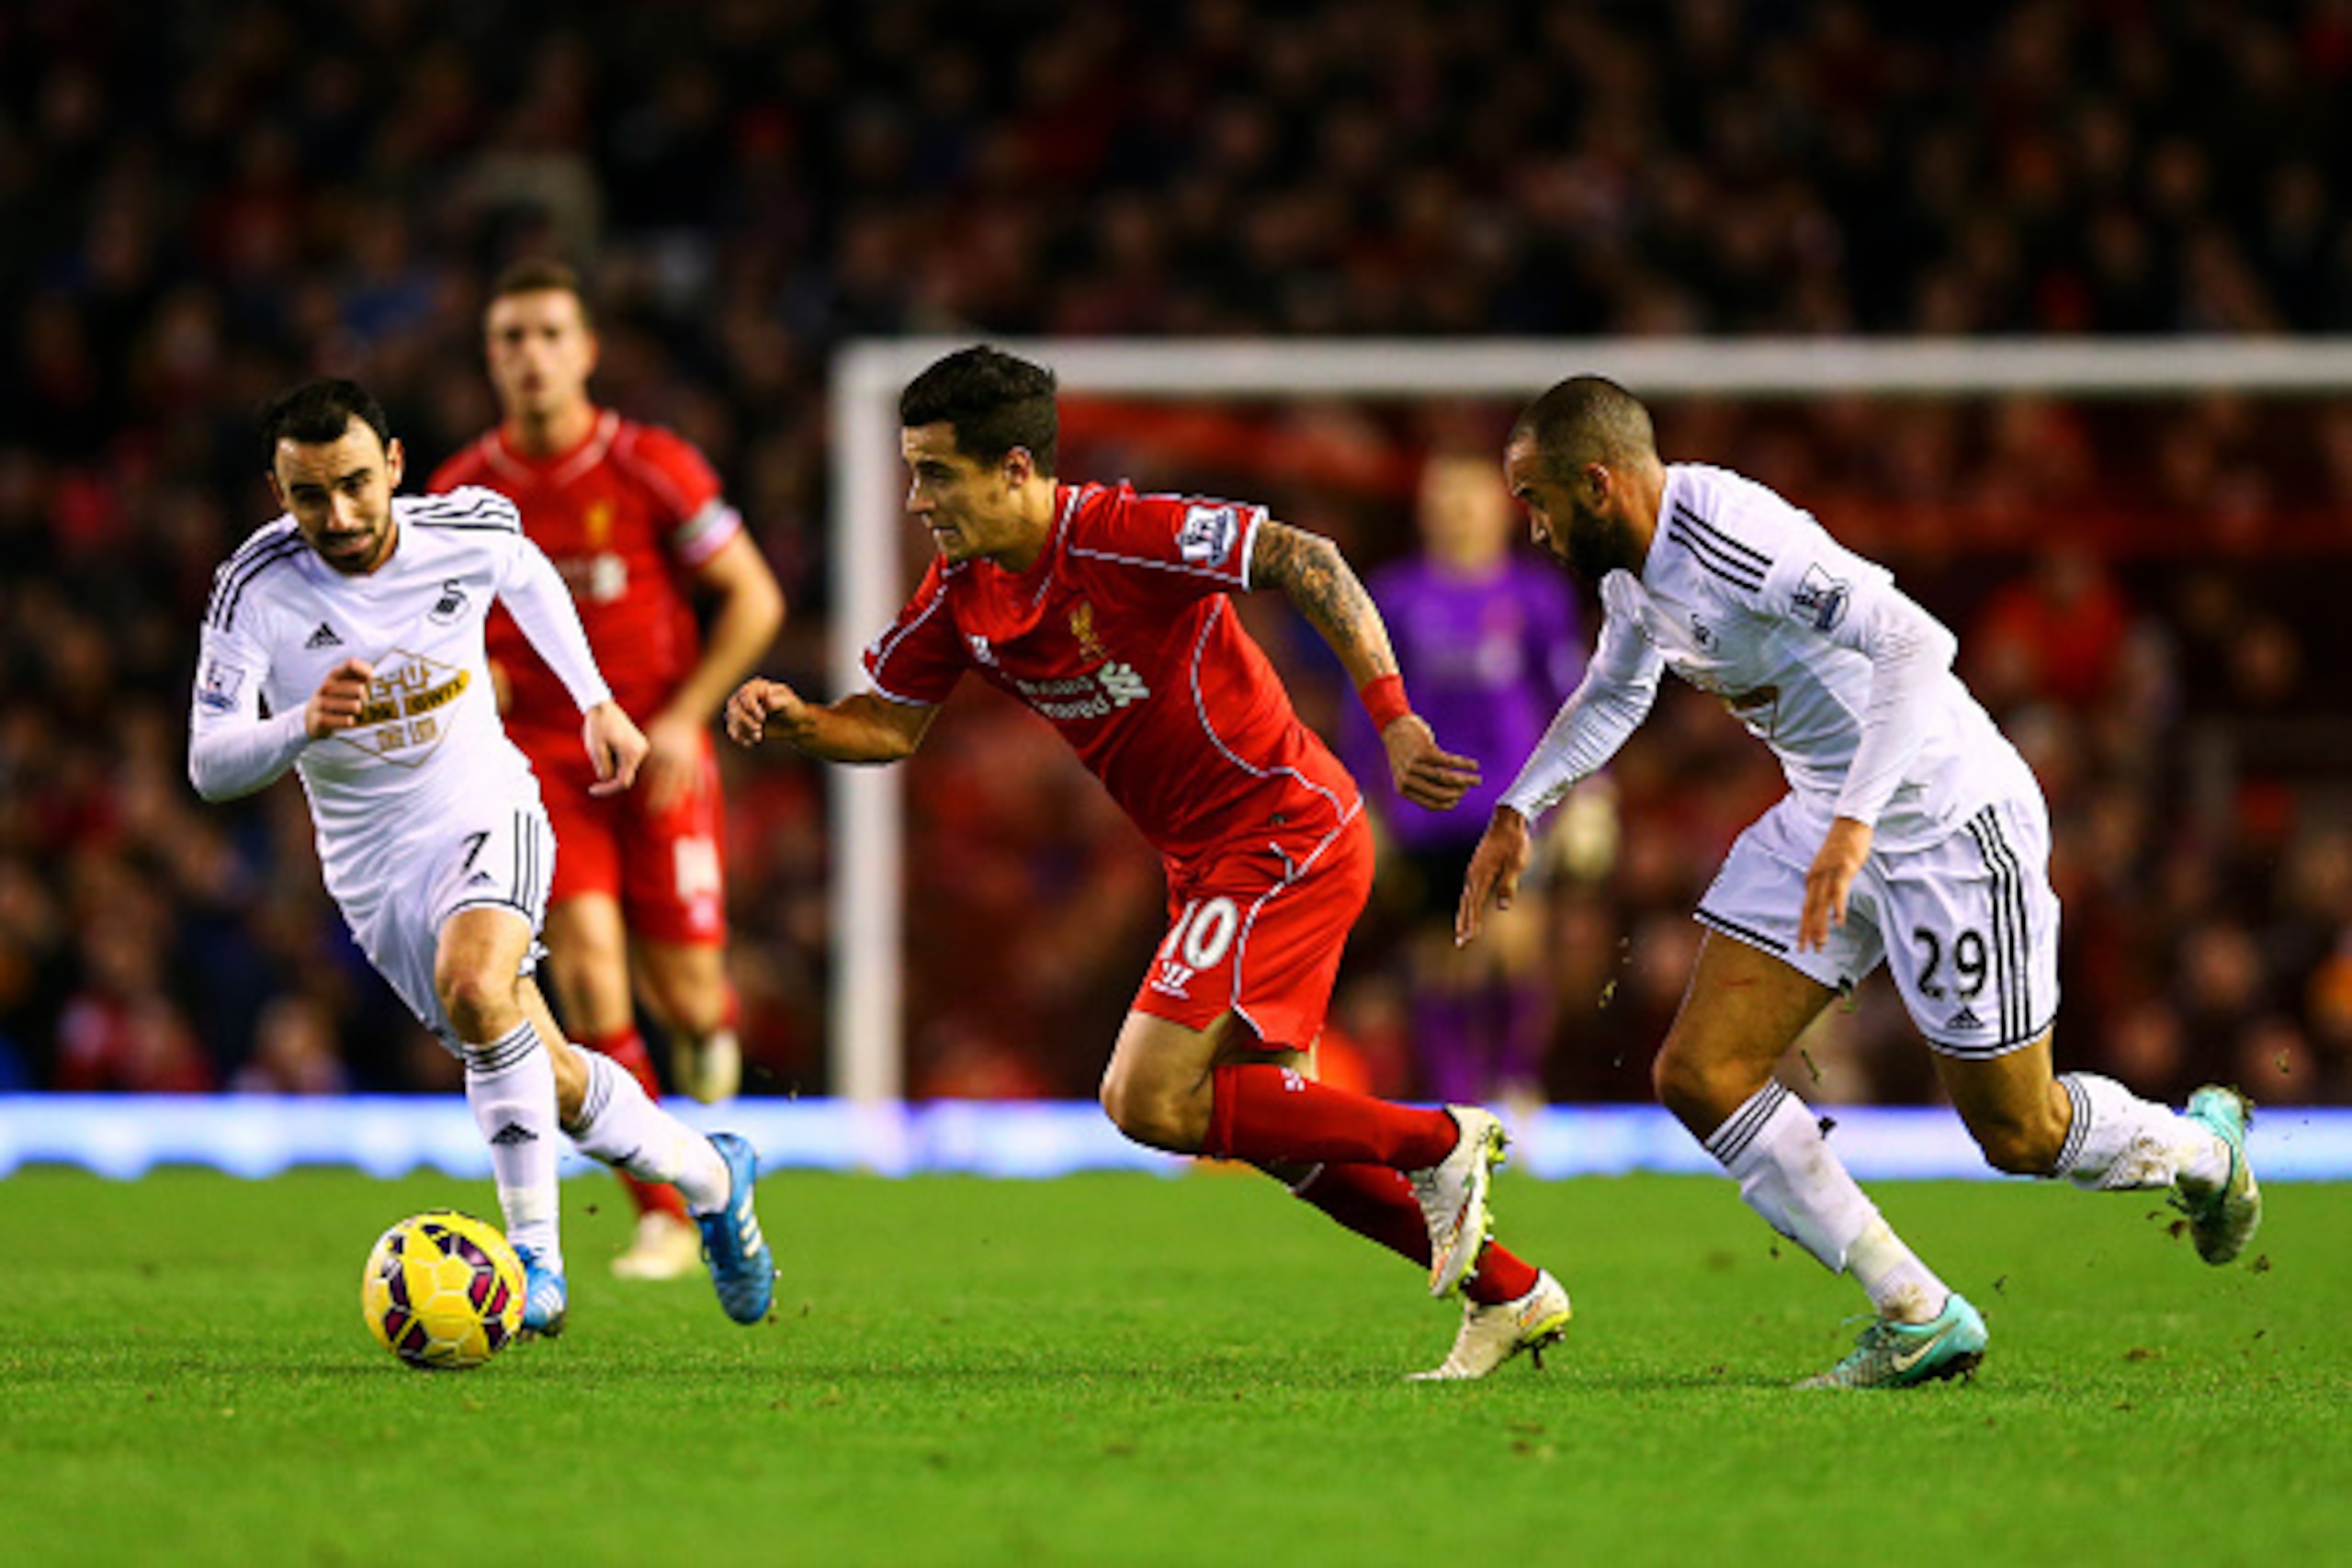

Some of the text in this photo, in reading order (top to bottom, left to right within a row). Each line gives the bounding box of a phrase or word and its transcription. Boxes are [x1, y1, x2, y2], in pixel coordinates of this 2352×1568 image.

[460, 830, 491, 874] 7
[1160, 897, 1237, 968] 10
[1913, 928, 1986, 1002] 29
